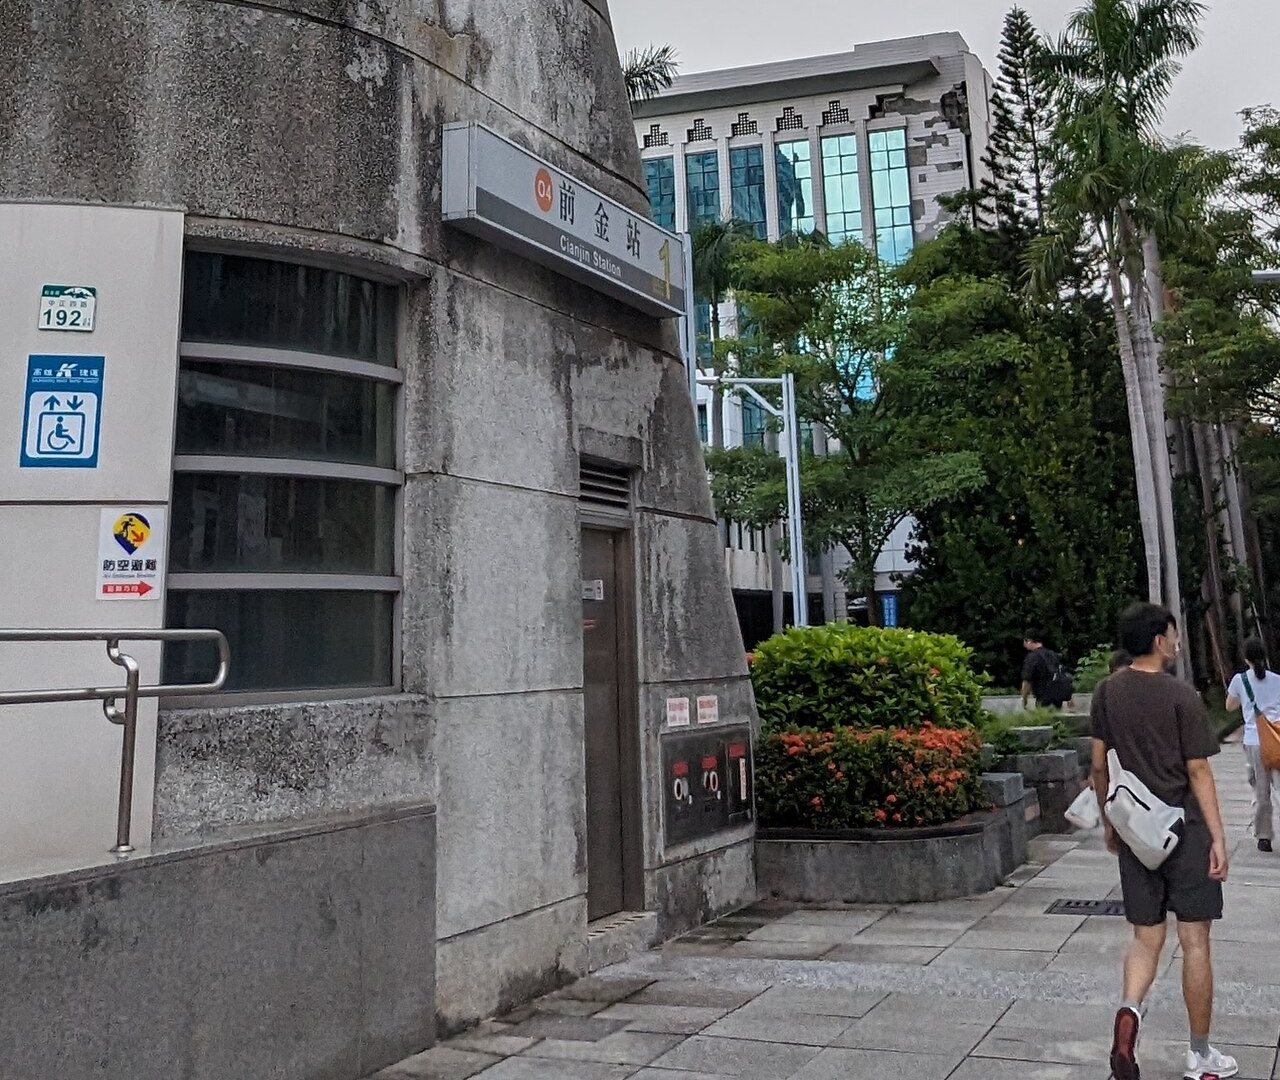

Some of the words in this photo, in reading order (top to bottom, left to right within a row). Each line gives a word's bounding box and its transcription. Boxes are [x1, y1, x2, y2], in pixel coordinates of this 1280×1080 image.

[559, 180, 641, 260] 前金站
[560, 234, 591, 263] Cianjin
[593, 250, 622, 278] Station
[658, 238, 671, 300] 1
[43, 309, 82, 326] 192
